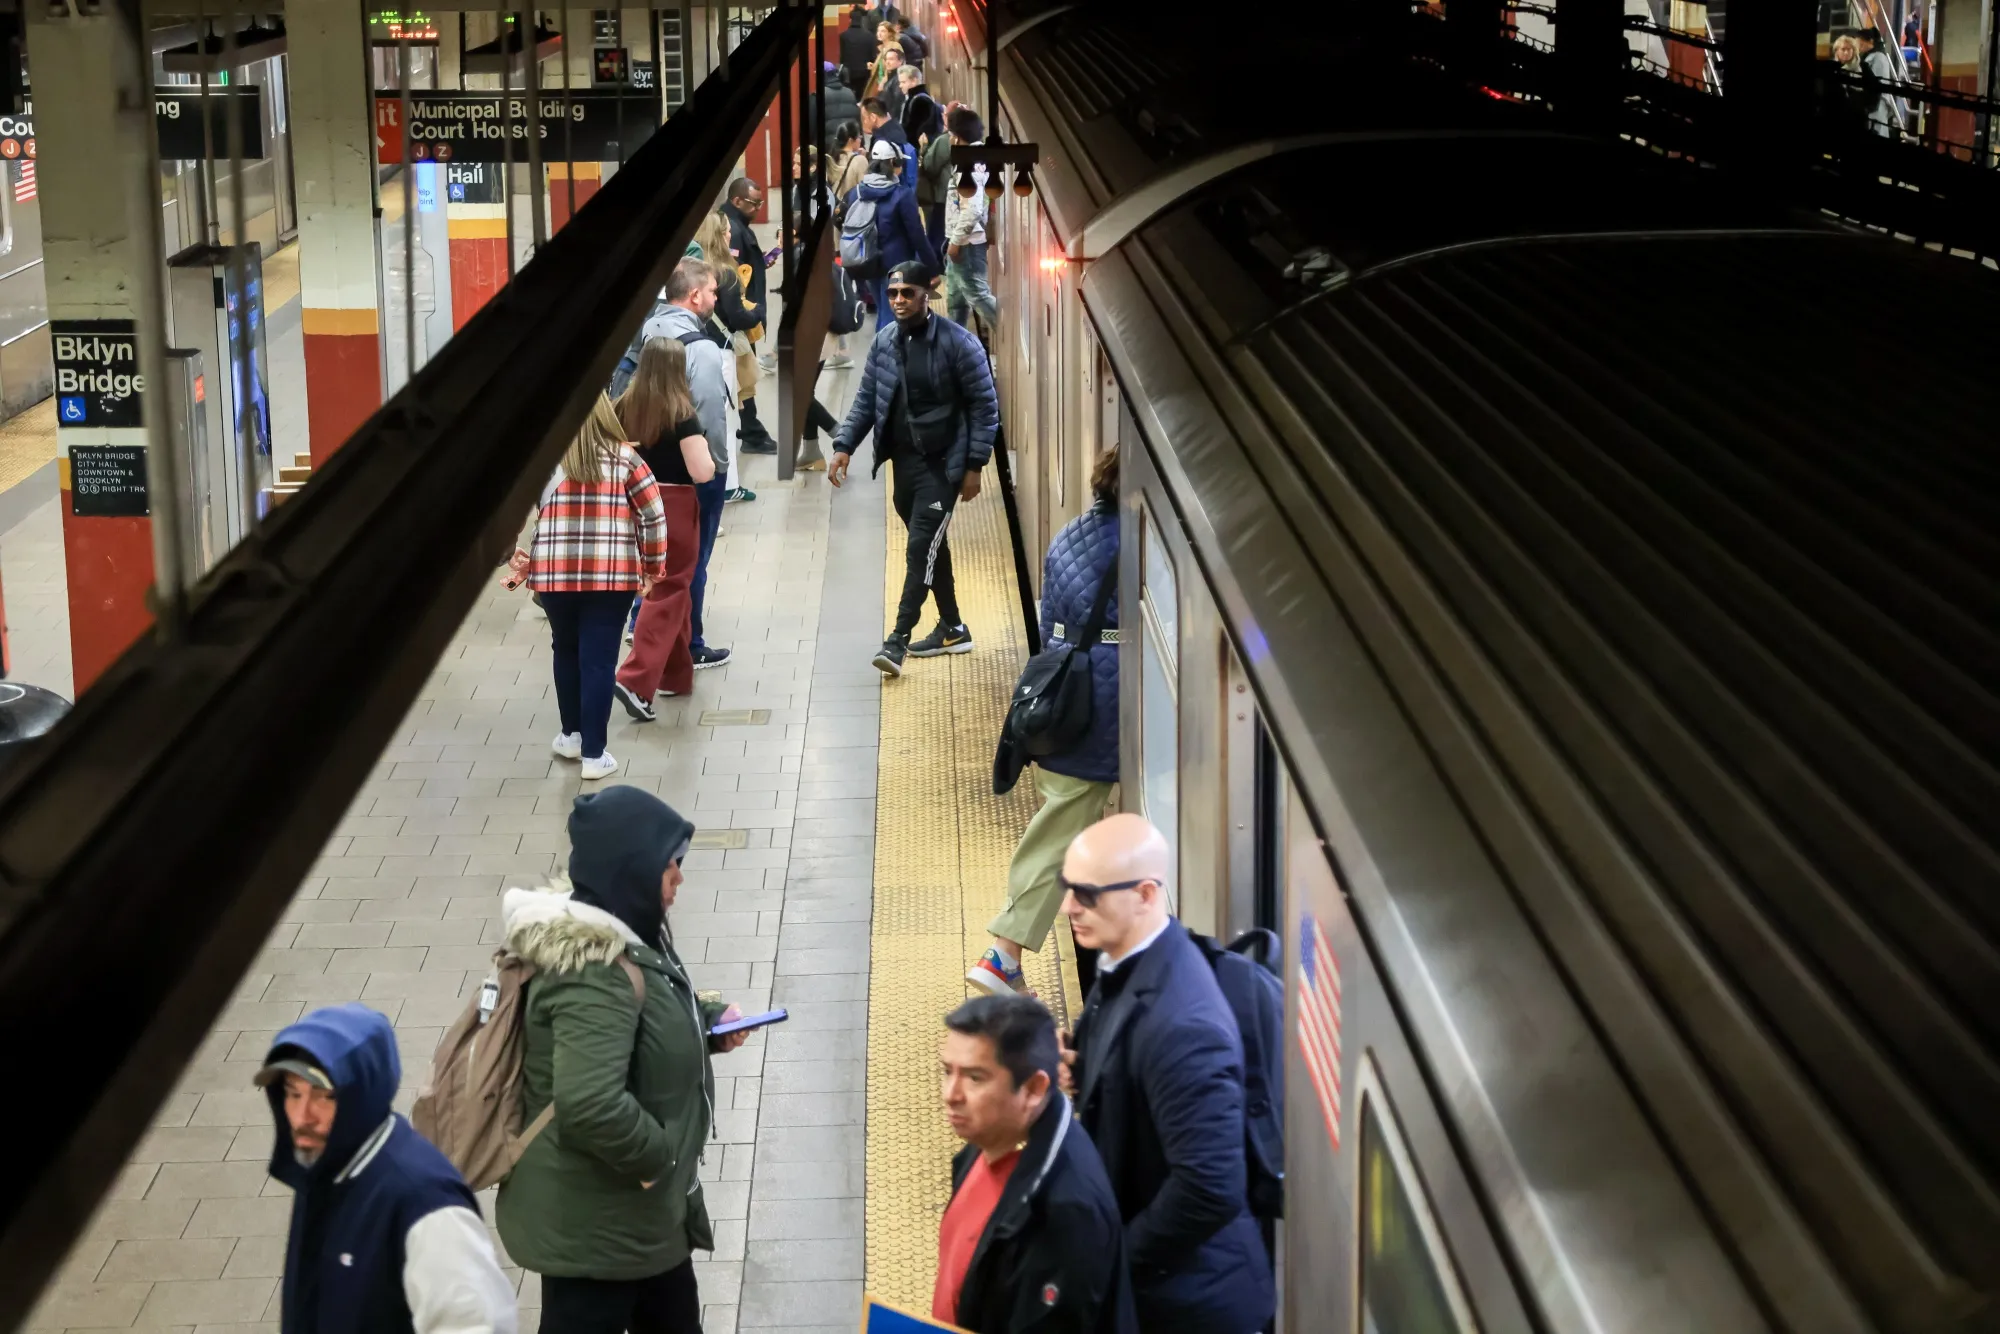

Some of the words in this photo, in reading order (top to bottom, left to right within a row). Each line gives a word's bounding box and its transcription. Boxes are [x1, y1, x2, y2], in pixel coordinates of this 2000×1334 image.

[410, 101, 500, 122] Municipal
[410, 121, 465, 139] Court
[448, 167, 484, 184] Hall
[56, 337, 133, 366] Bklyn
[58, 368, 146, 398] Bridge
